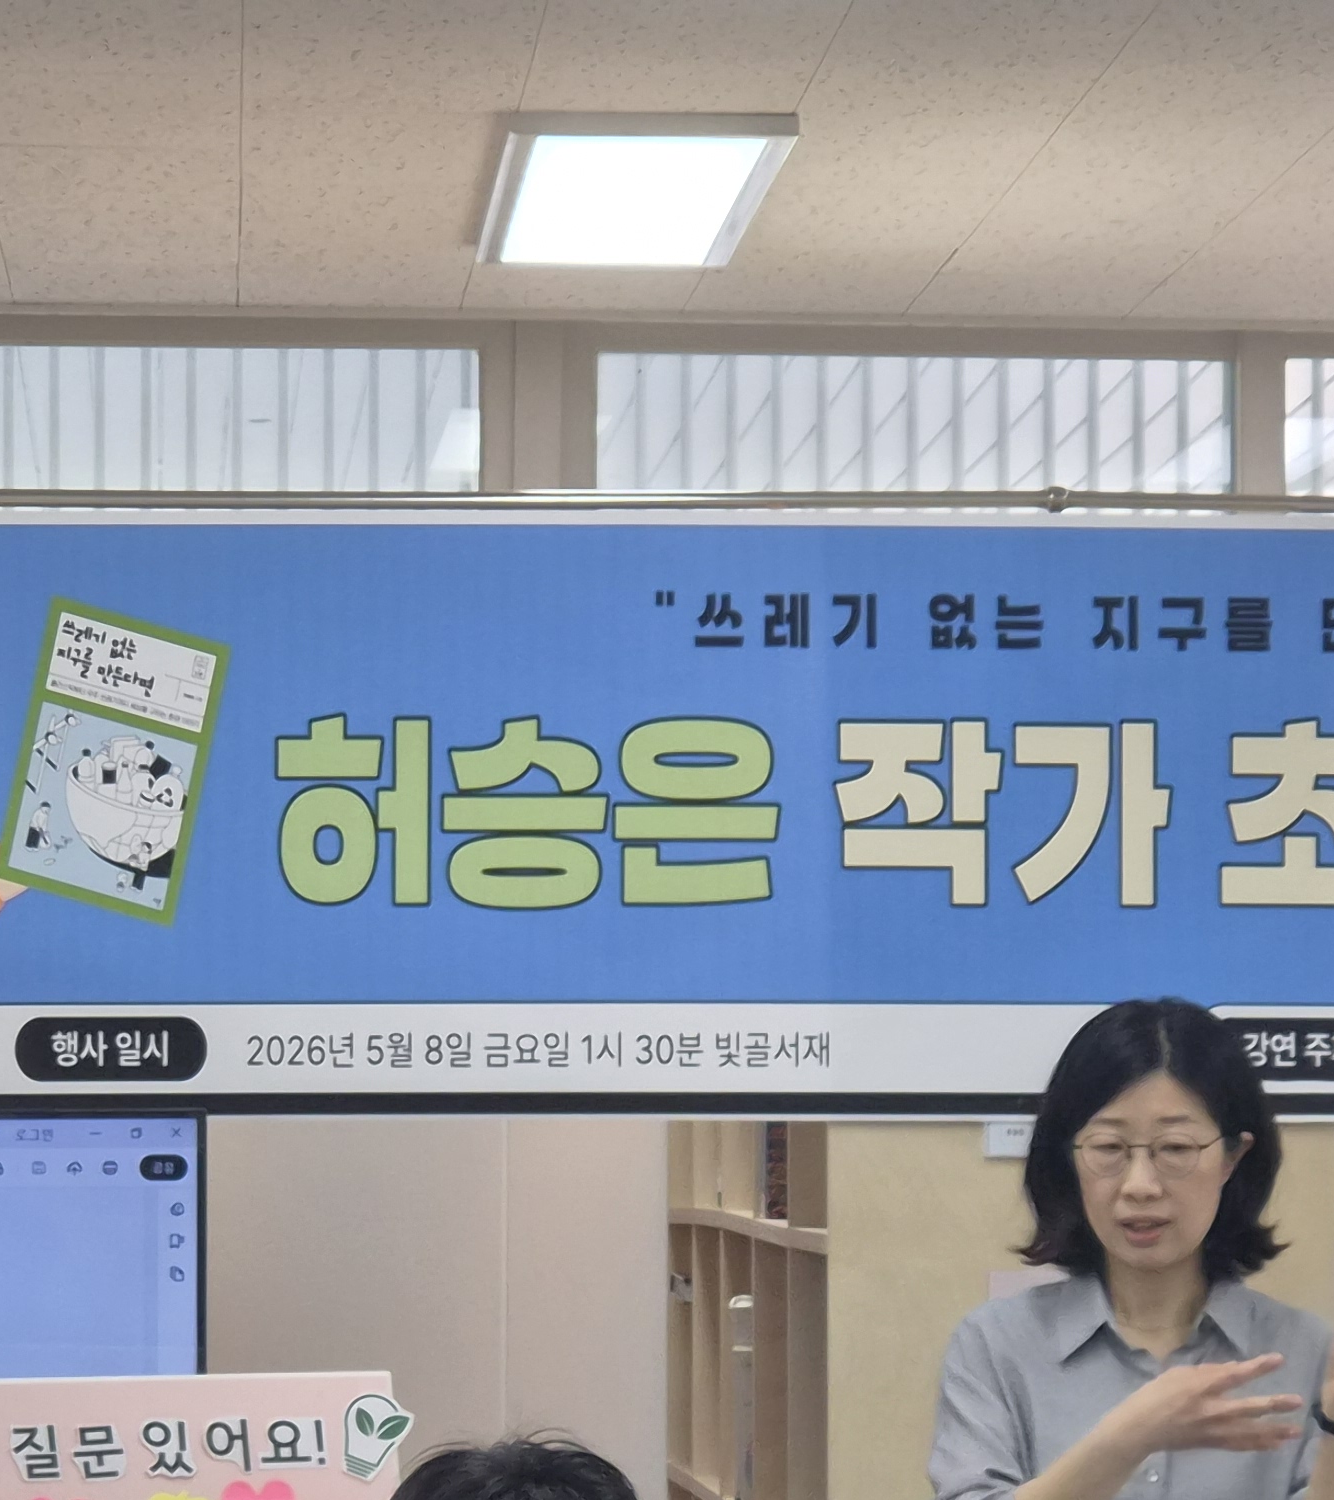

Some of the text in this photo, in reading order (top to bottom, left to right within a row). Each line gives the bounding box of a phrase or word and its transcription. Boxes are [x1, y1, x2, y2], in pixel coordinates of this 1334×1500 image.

[62, 619, 138, 661] 쓰레기 없는
[656, 591, 876, 650] "쓰레기
[929, 594, 1044, 651] 없는
[1092, 596, 1272, 652] 지구를
[56, 646, 155, 698] 지구를 만든다면
[275, 713, 781, 910] 허승은
[833, 717, 1173, 909] 작가
[51, 1030, 169, 1067] 행사 일시
[246, 1031, 830, 1069] 2026년 5월 8일 금요일 1시 30분 빛골서재
[1242, 1031, 1297, 1068] 강연
